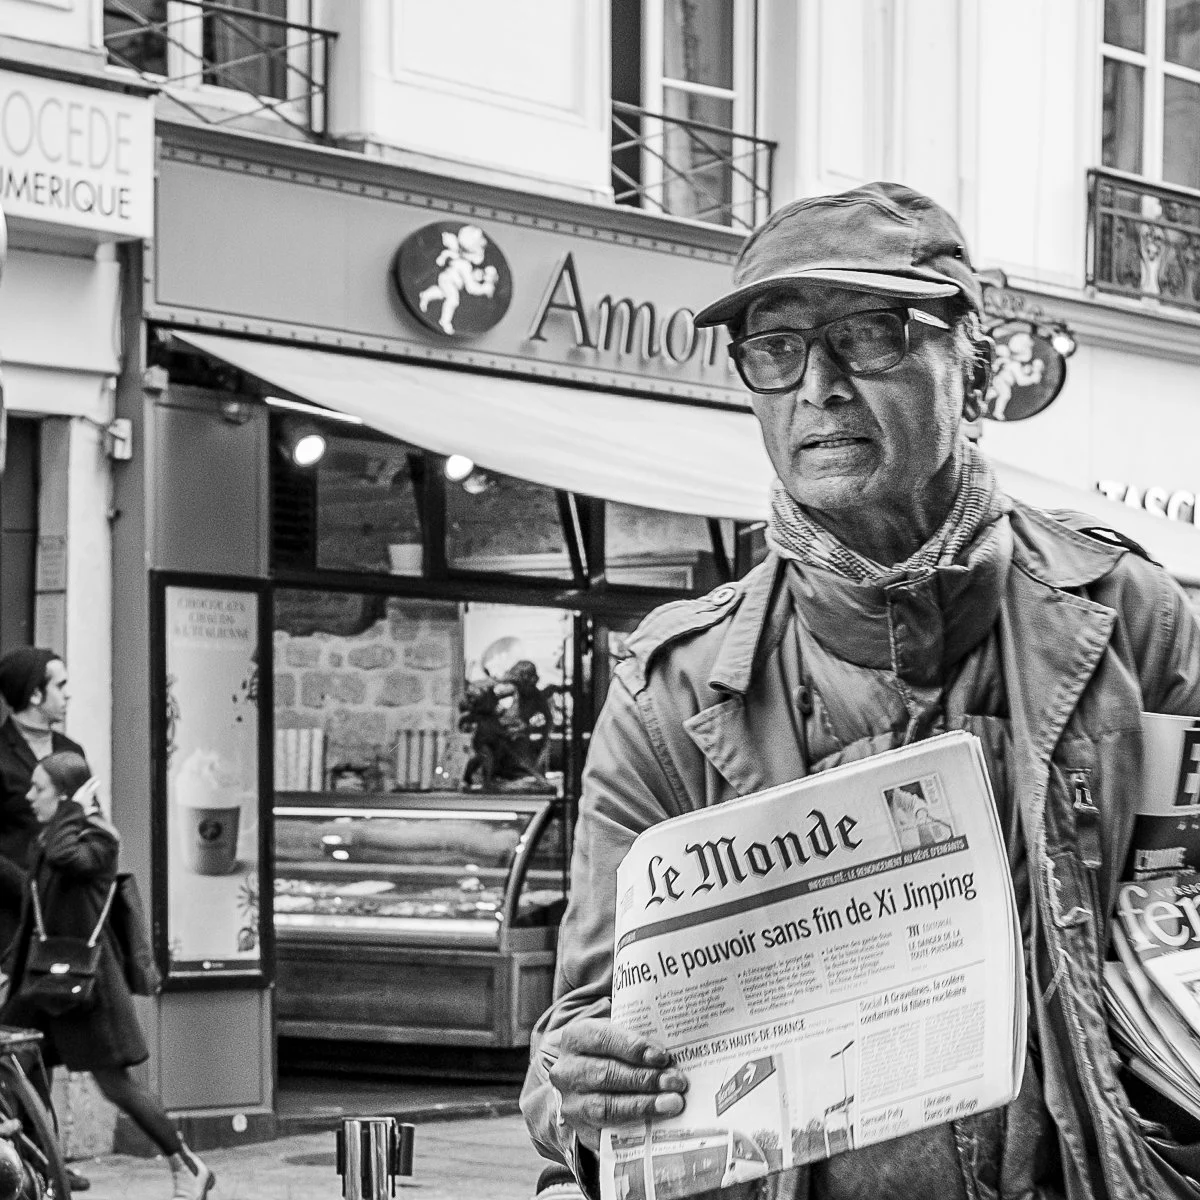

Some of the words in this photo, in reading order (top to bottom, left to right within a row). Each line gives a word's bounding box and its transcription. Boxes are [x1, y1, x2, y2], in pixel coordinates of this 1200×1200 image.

[645, 855, 685, 910] Le
[684, 809, 863, 897] Monde
[657, 951, 679, 977] le
[681, 929, 756, 978] pouvoir
[762, 916, 811, 949] sans
[812, 906, 843, 935] fin
[845, 896, 873, 926] de
[873, 887, 897, 918] Xi
[902, 872, 977, 911] Jinping
